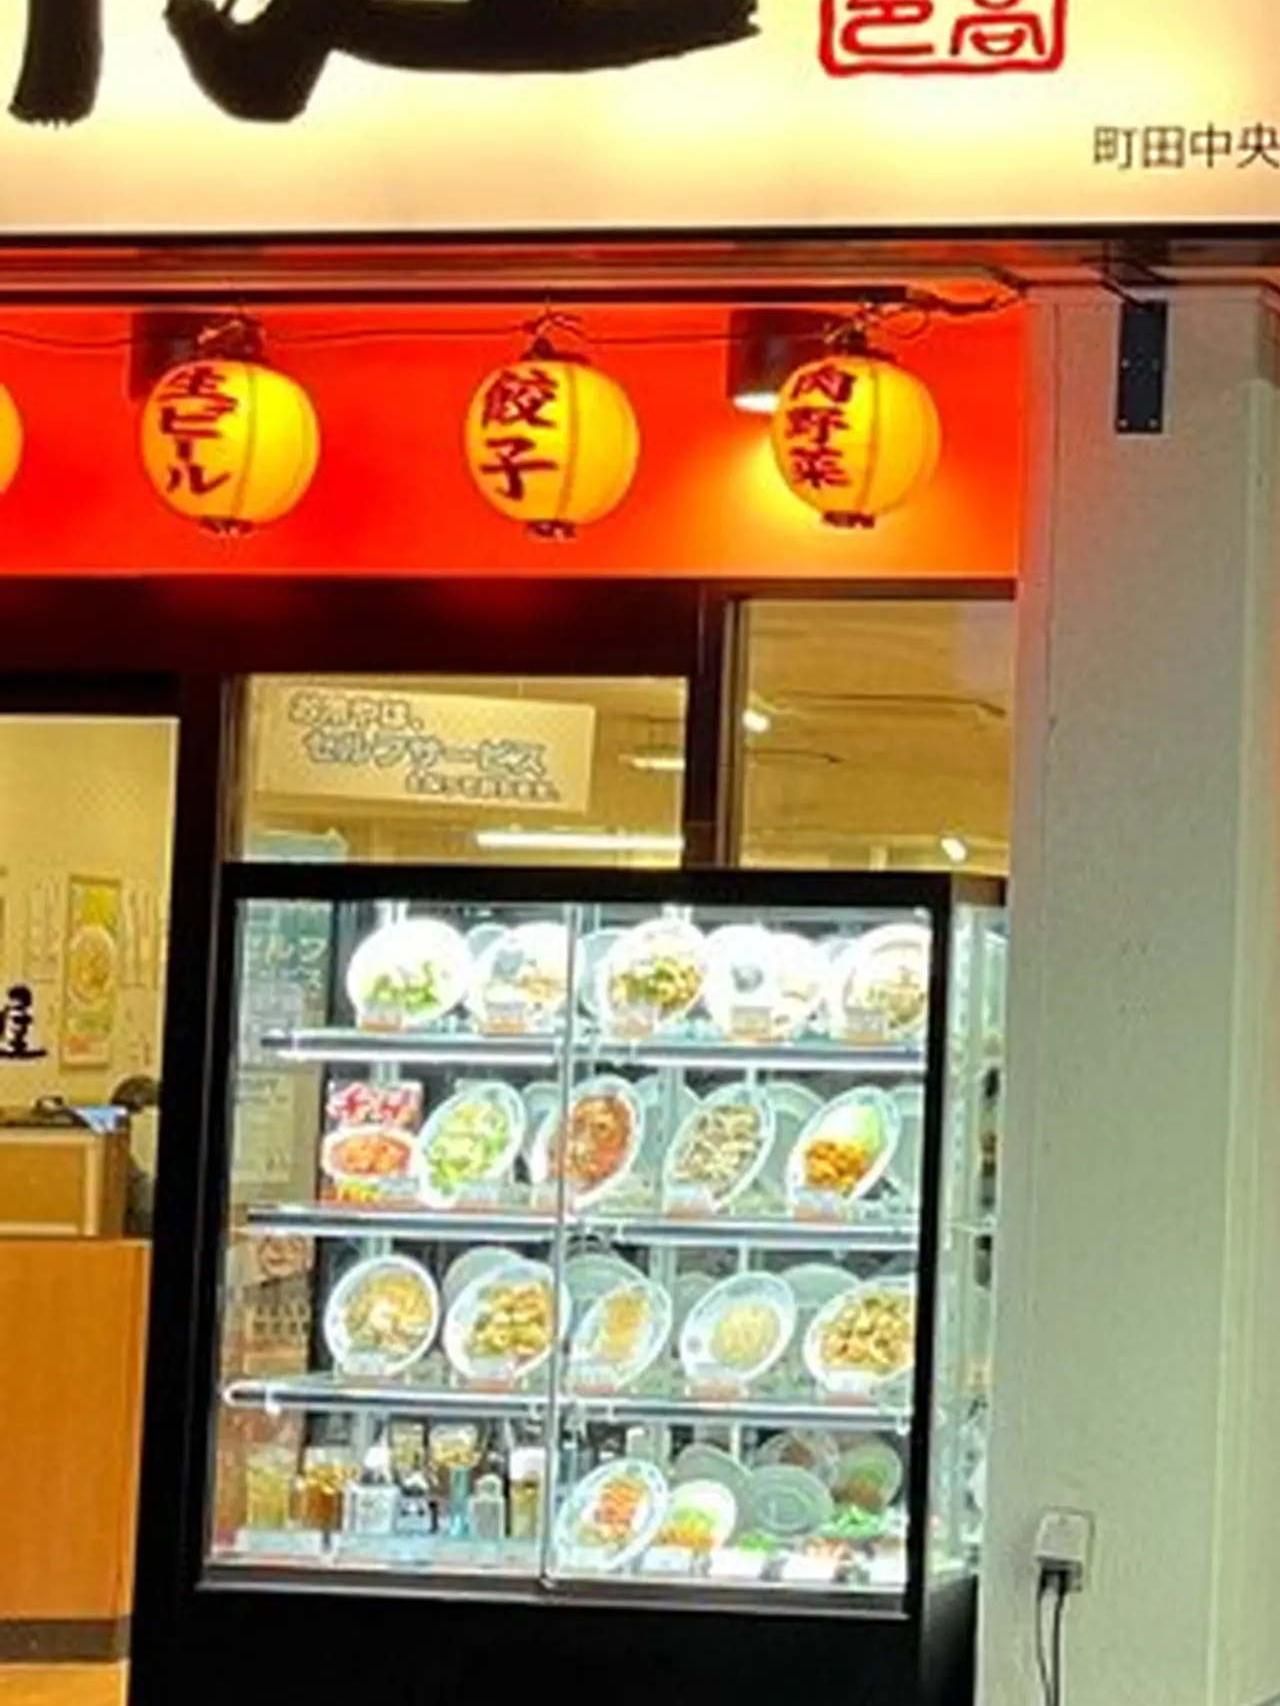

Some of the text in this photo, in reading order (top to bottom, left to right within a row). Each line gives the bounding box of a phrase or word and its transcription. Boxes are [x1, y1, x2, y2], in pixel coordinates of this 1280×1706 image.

[156, 366, 239, 496] 生ビール
[479, 368, 560, 502] 餃子
[784, 364, 855, 490] 肉野菜
